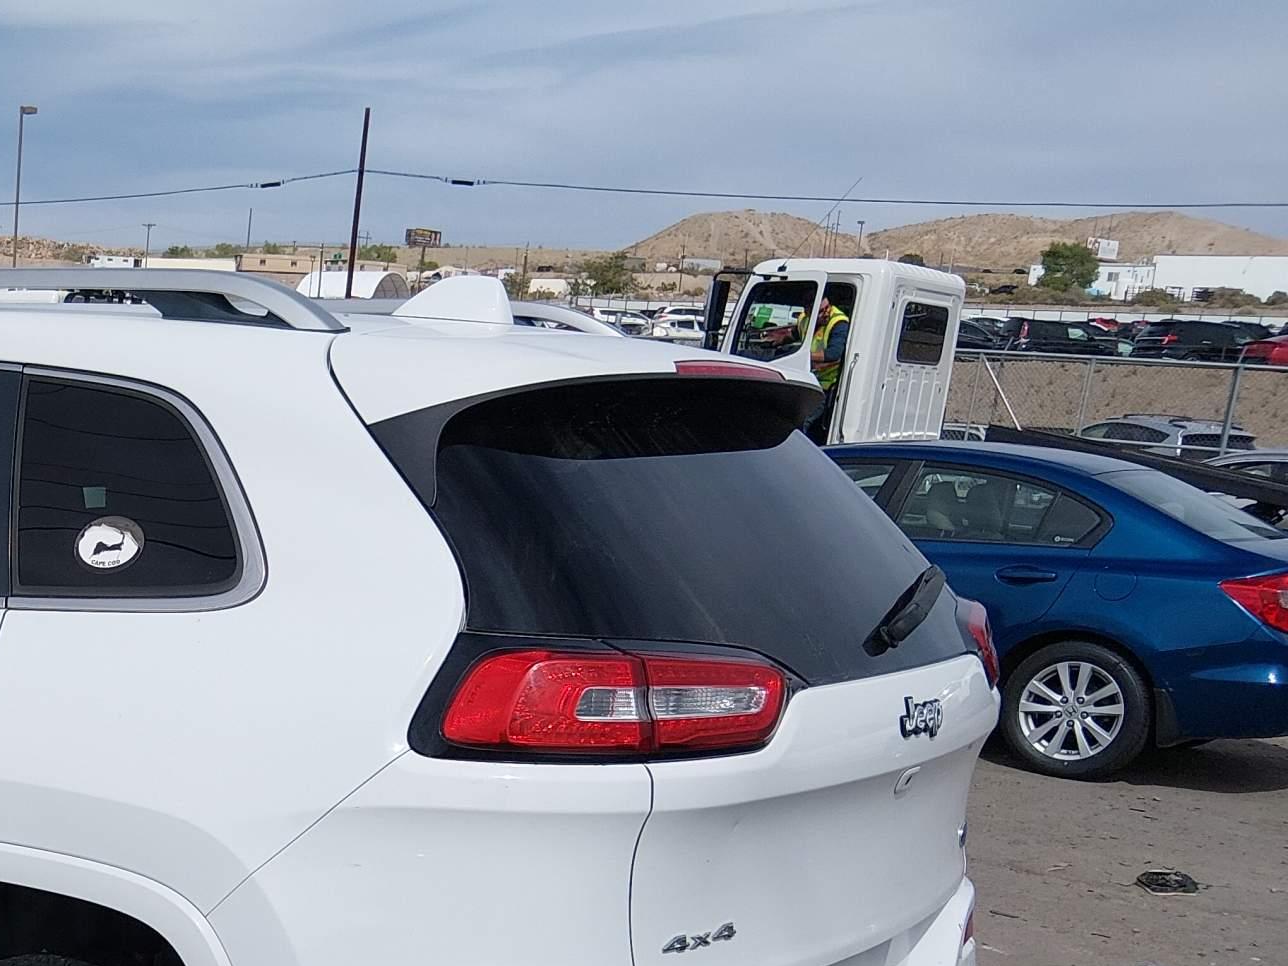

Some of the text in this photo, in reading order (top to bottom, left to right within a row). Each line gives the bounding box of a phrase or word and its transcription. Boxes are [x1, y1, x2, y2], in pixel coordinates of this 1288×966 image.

[91, 559, 121, 567] CAPE COD
[899, 696, 943, 738] Jeep
